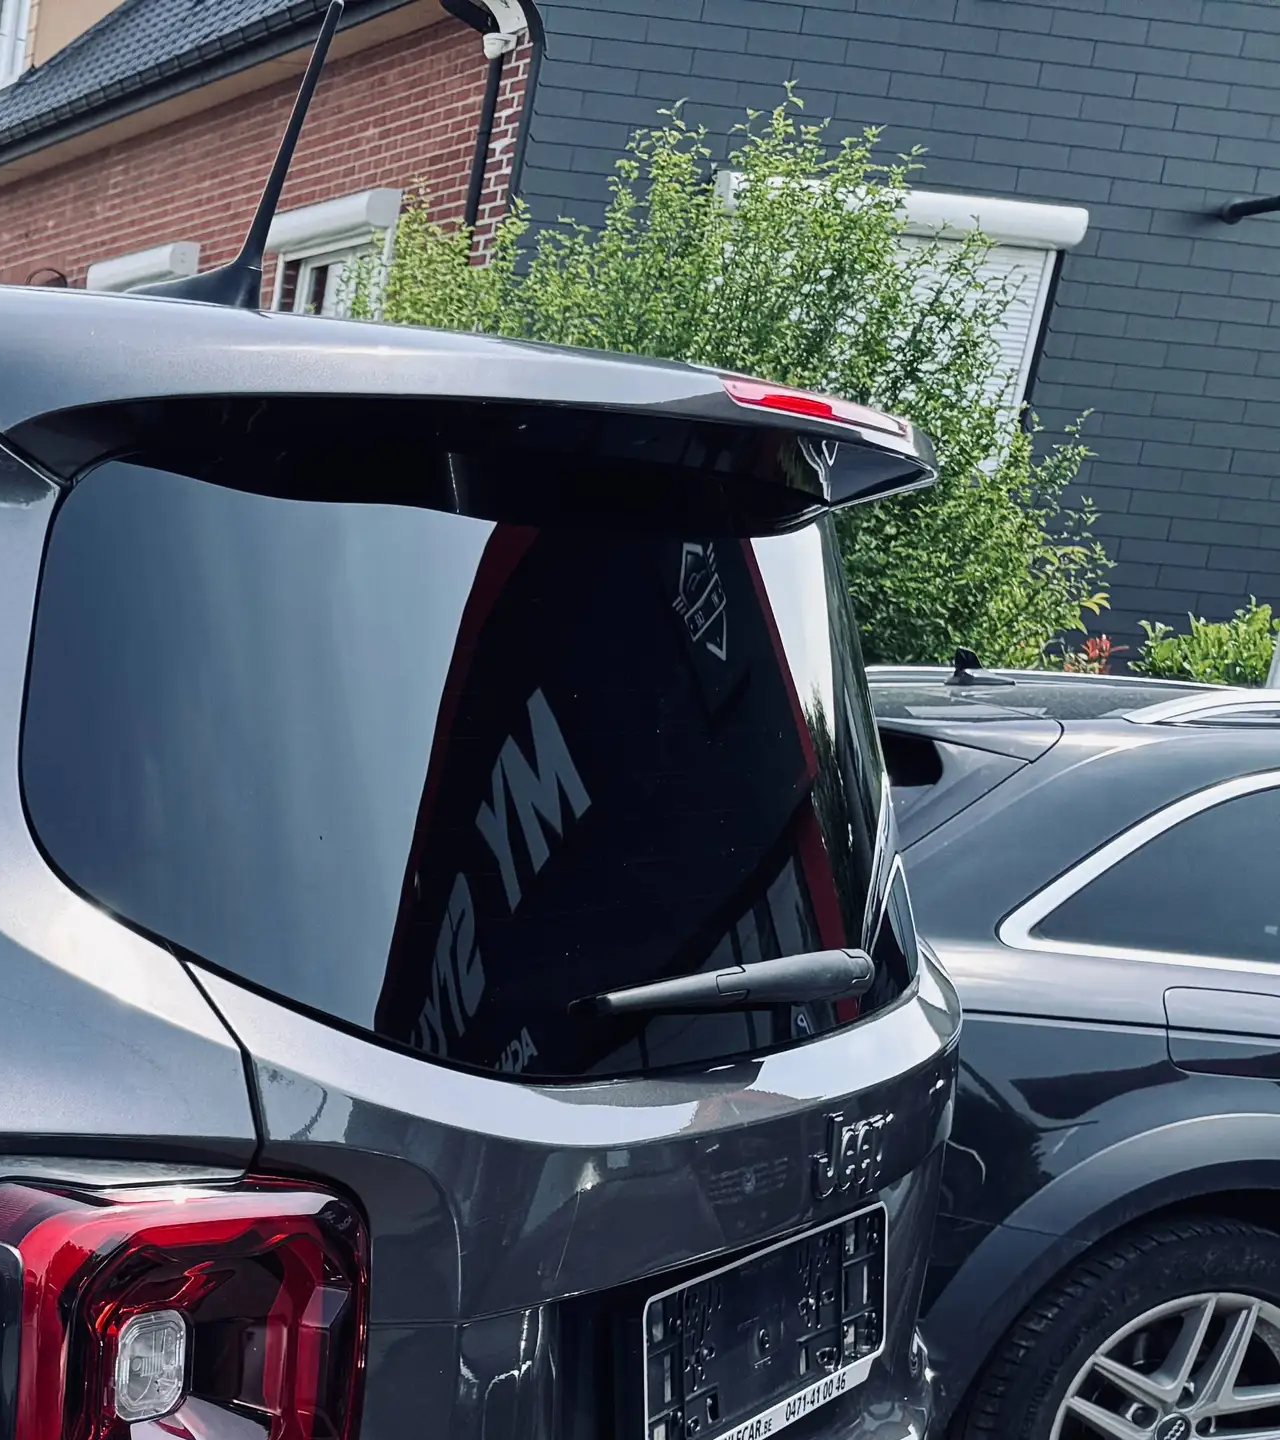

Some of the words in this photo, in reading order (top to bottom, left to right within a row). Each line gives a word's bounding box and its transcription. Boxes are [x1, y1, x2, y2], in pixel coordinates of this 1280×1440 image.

[785, 1386, 821, 1422] 0471-41
[823, 1382, 834, 1400] 00
[835, 1372, 846, 1393] 46
